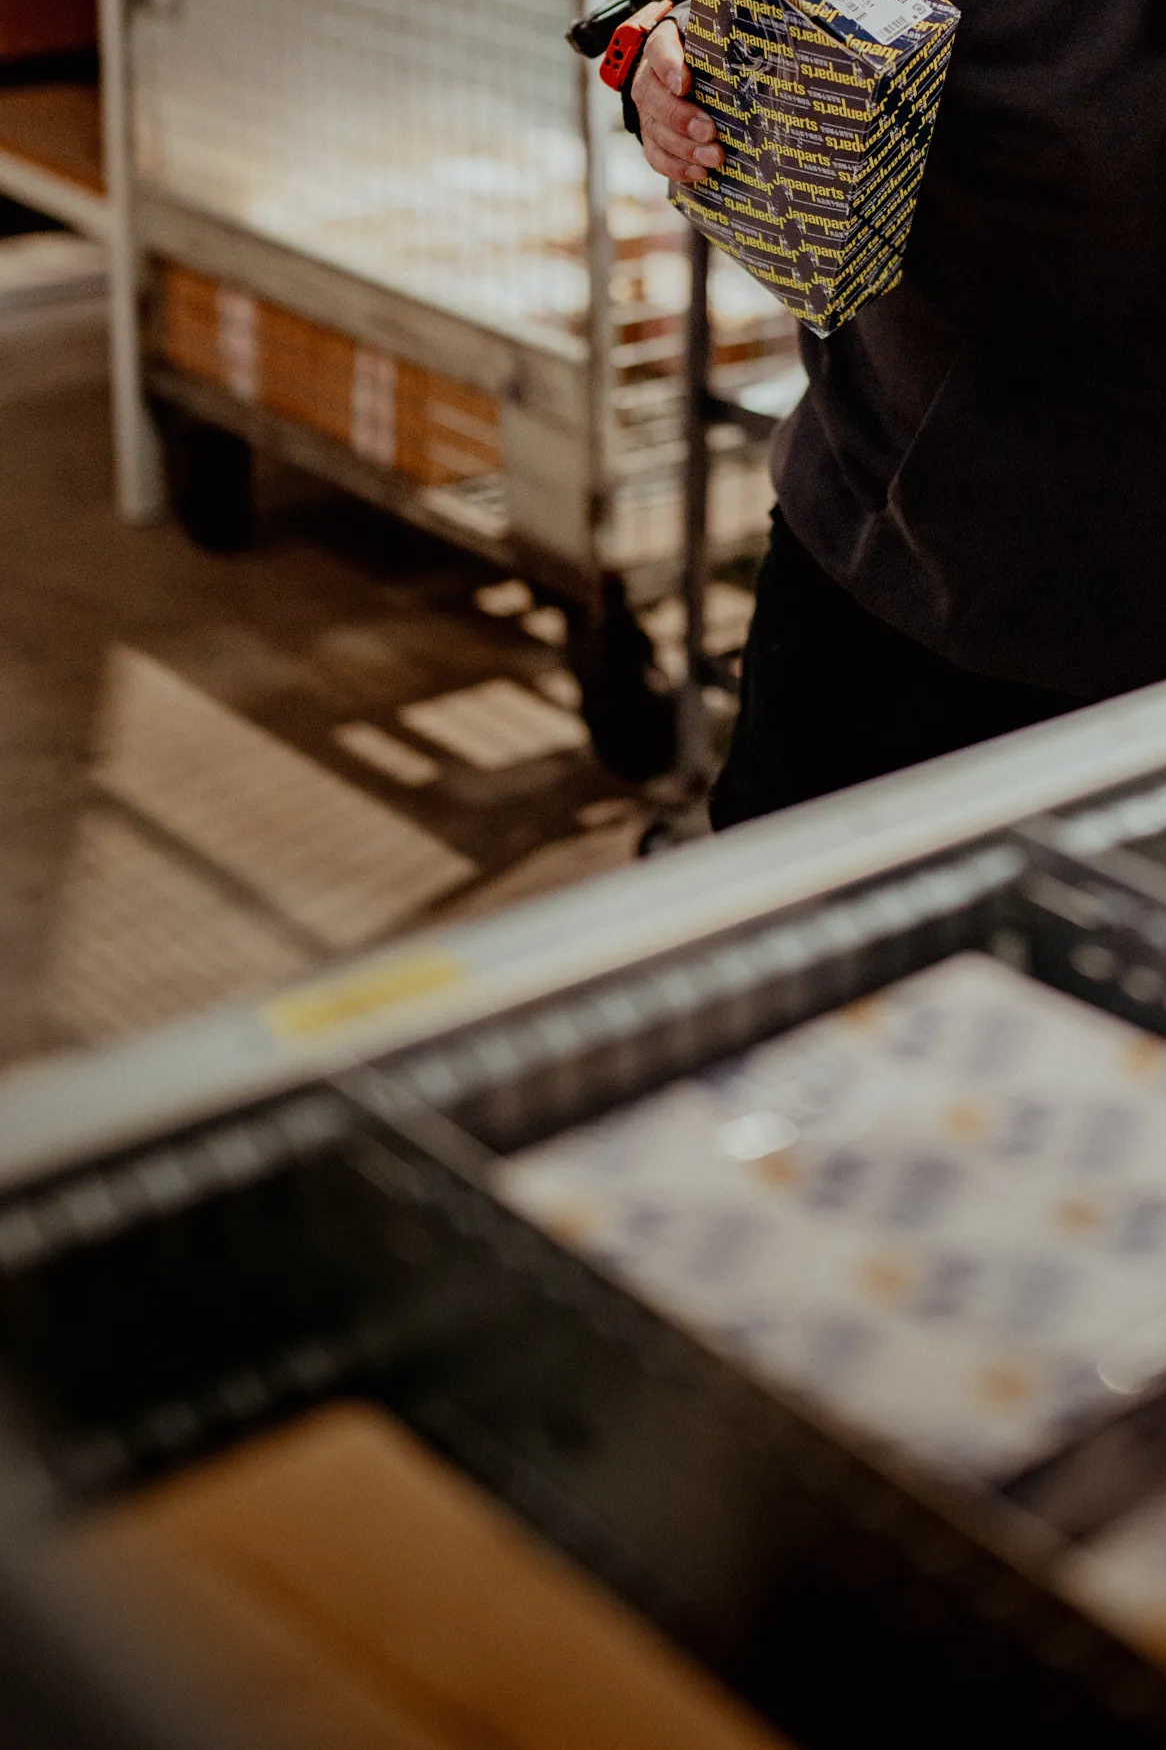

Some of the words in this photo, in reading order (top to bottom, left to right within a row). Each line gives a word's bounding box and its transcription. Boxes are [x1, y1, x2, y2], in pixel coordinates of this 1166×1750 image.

[729, 25, 794, 59] Japanparts
[685, 51, 740, 89] Japanparts
[739, 62, 806, 97] Japanparts
[800, 62, 875, 93] Japanparts
[695, 89, 751, 126] Japanparts
[750, 100, 818, 134] Japanparts
[761, 137, 831, 168] Japanparts
[773, 171, 845, 202] Japanparts
[853, 132, 920, 209] Japanparts
[724, 196, 787, 229] Japanparts
[785, 206, 858, 235] Japanparts
[735, 232, 800, 263] Japanparts
